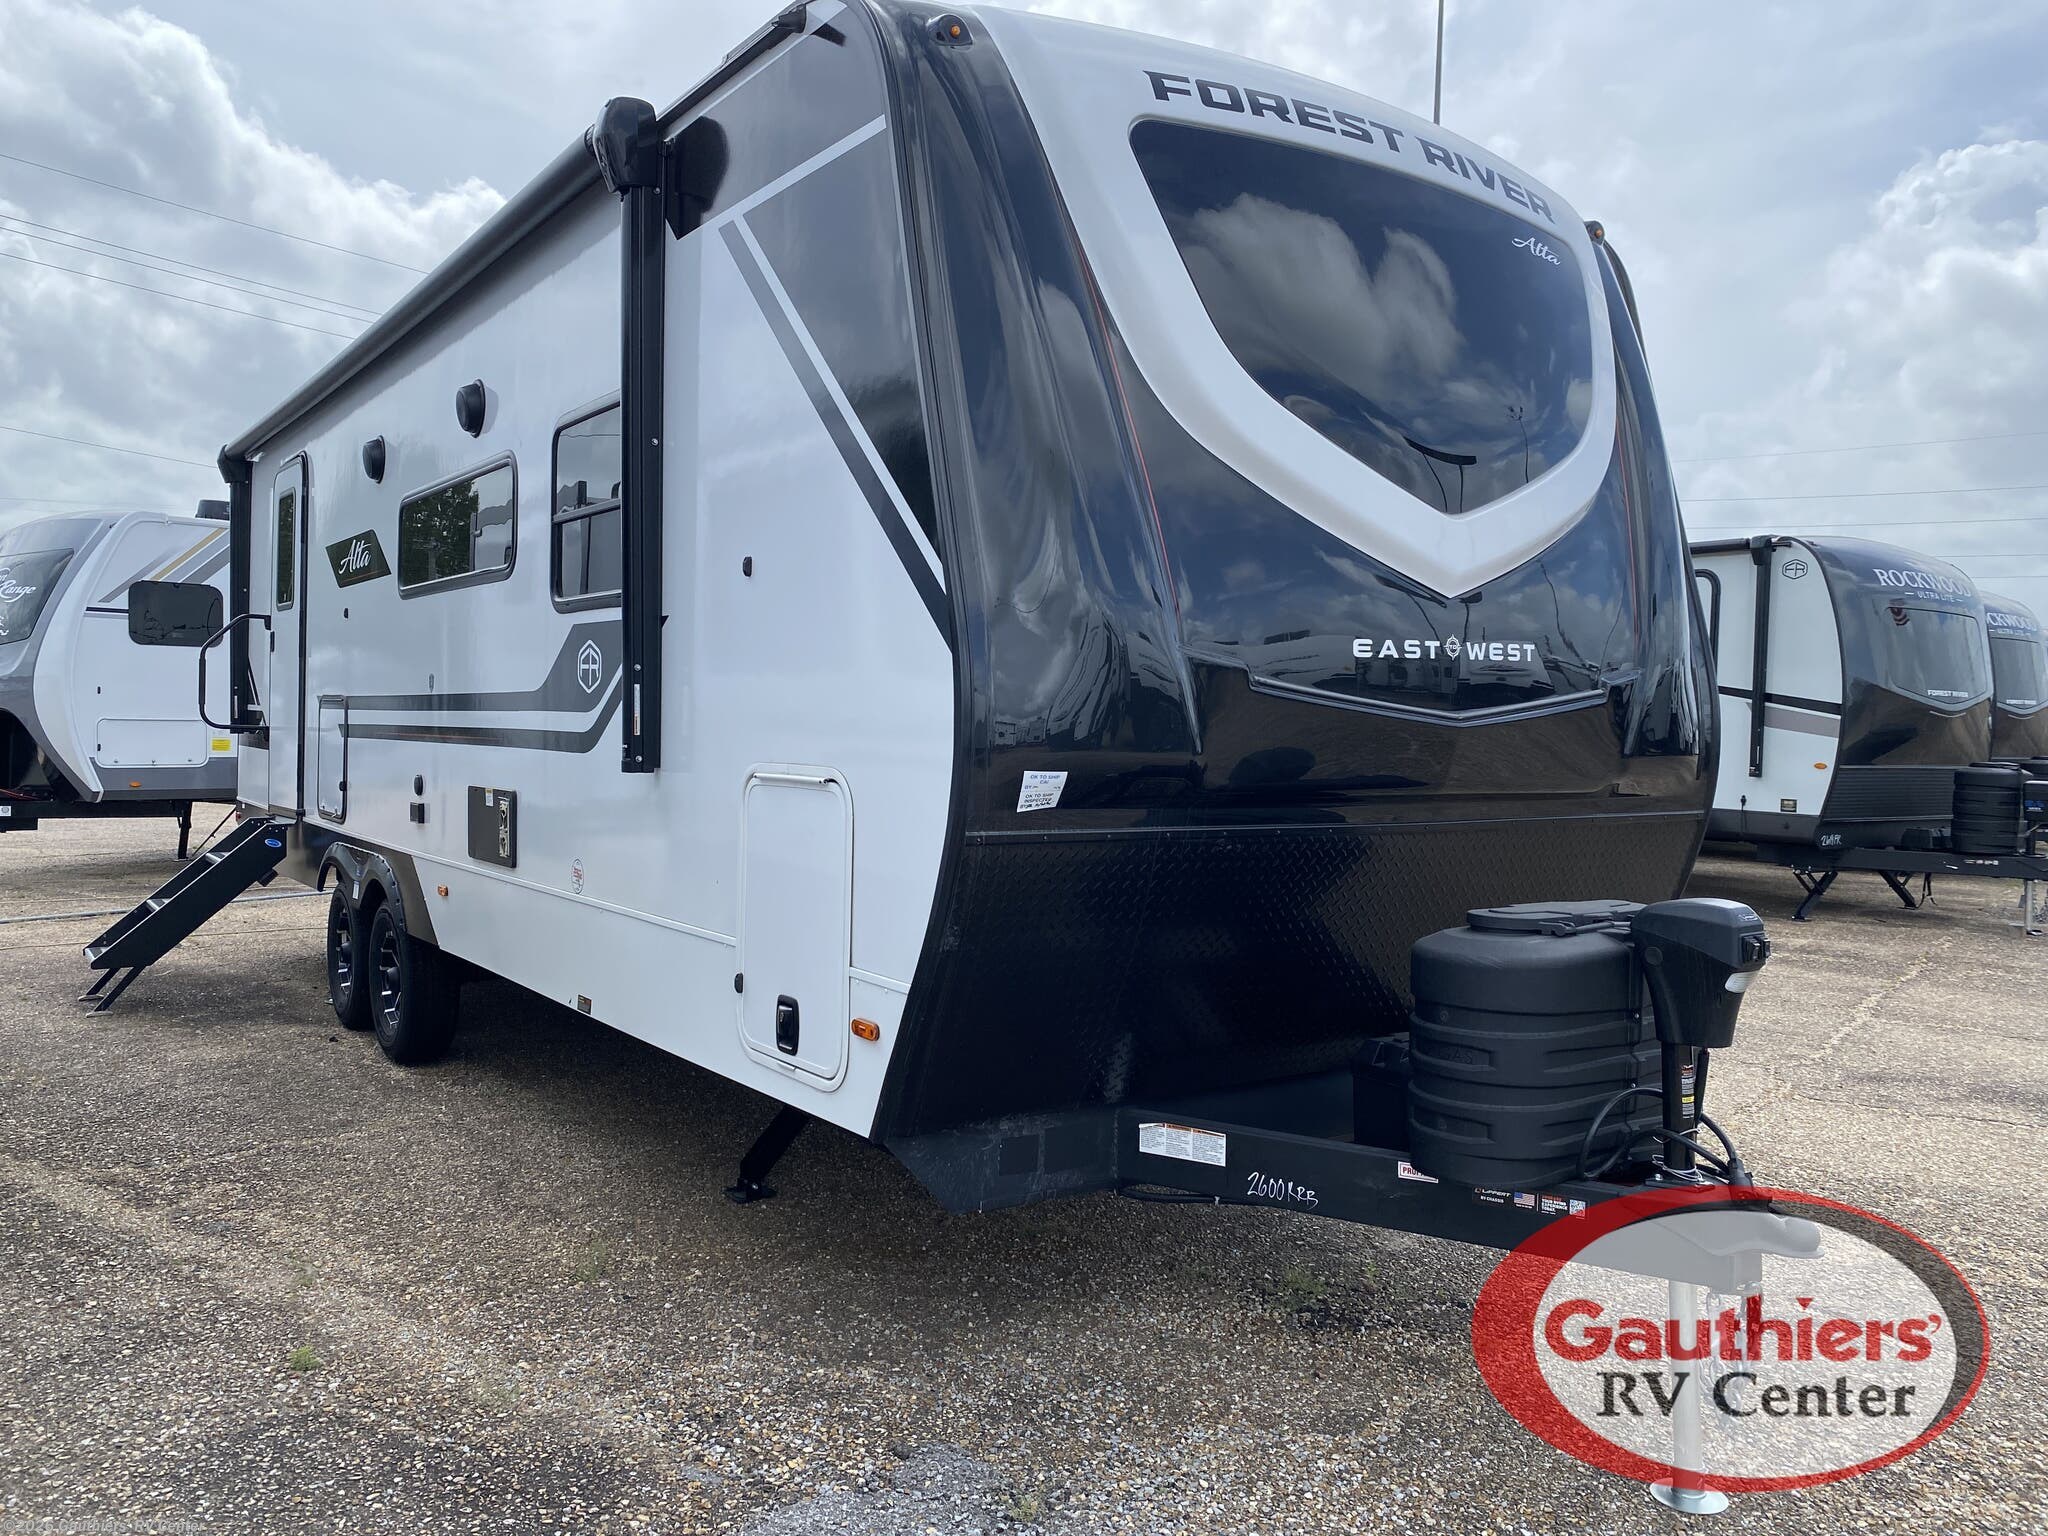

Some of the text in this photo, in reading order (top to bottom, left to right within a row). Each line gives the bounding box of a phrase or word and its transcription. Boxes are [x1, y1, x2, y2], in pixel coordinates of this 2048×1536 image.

[1143, 70, 1556, 224] FOREST RIVER
[1511, 237, 1561, 265] Alta
[338, 539, 372, 574] Alta
[1872, 568, 1971, 597] ROCKWOOD
[1917, 591, 1939, 600] ULTRA
[1353, 639, 1439, 659] EAST
[1467, 642, 1535, 661] WEST
